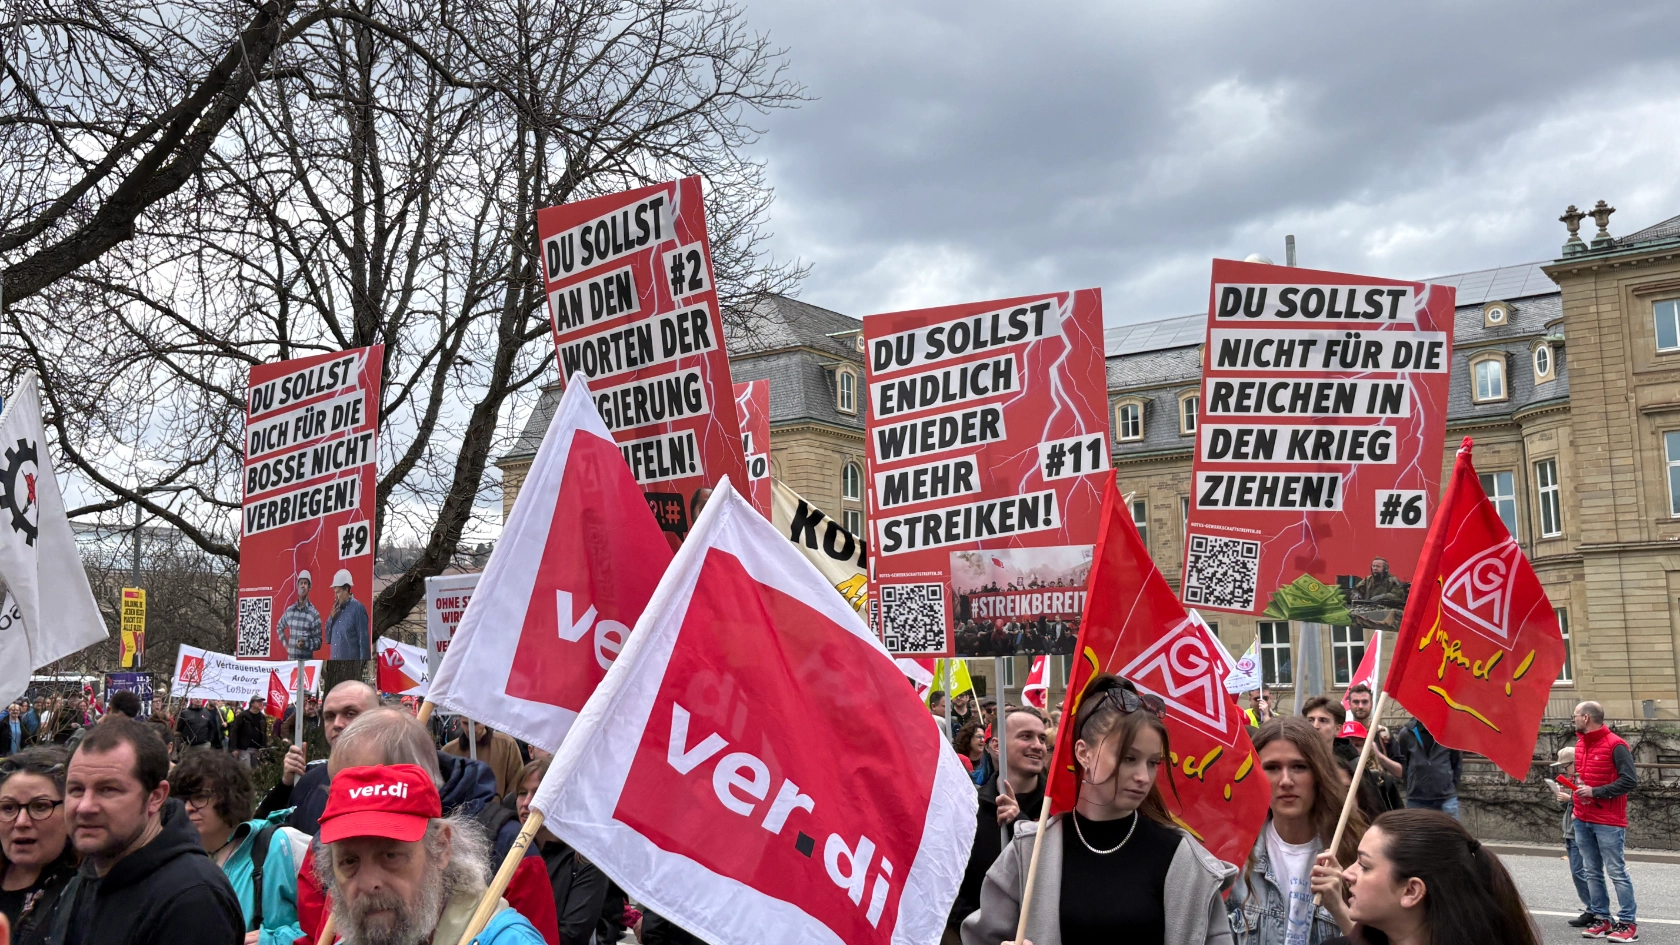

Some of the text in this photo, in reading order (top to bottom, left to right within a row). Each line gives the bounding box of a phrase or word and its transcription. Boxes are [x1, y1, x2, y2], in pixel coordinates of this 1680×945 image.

[548, 196, 664, 279] DU SOLLST
[671, 250, 703, 297] #2
[558, 270, 633, 332] AN DEN
[1217, 286, 1407, 320] DU SOLLST
[562, 308, 711, 381] WORTEN DER
[873, 301, 1051, 373] DU SOLLST
[1217, 331, 1444, 370] NICHT FÜR DIE
[250, 356, 355, 416] DU SOLLST
[594, 372, 702, 430] GIERUNG
[879, 357, 1013, 416] ENDLICH
[1209, 381, 1405, 414] REICHEN IN
[250, 398, 363, 456] DICH FÜR DIE
[878, 407, 1001, 458] WIEDER
[1207, 428, 1393, 461] DEN KRIEG
[247, 432, 373, 495] BOSSE NICHT
[620, 432, 697, 482] FELN!
[1045, 437, 1101, 478] #11
[247, 478, 357, 534] VERBIEGEN!
[882, 460, 974, 507] MEHR
[1198, 475, 1340, 509] ZIEHEN!
[882, 492, 1053, 553] STREIKEN!
[1379, 493, 1423, 525] #6
[341, 525, 368, 557] #9
[436, 596, 460, 610] OHNE
[215, 660, 280, 674] Vertrauensleute
[226, 684, 262, 696] Loßburg
[349, 781, 409, 799] ver.di
[667, 701, 894, 930] ver.di
